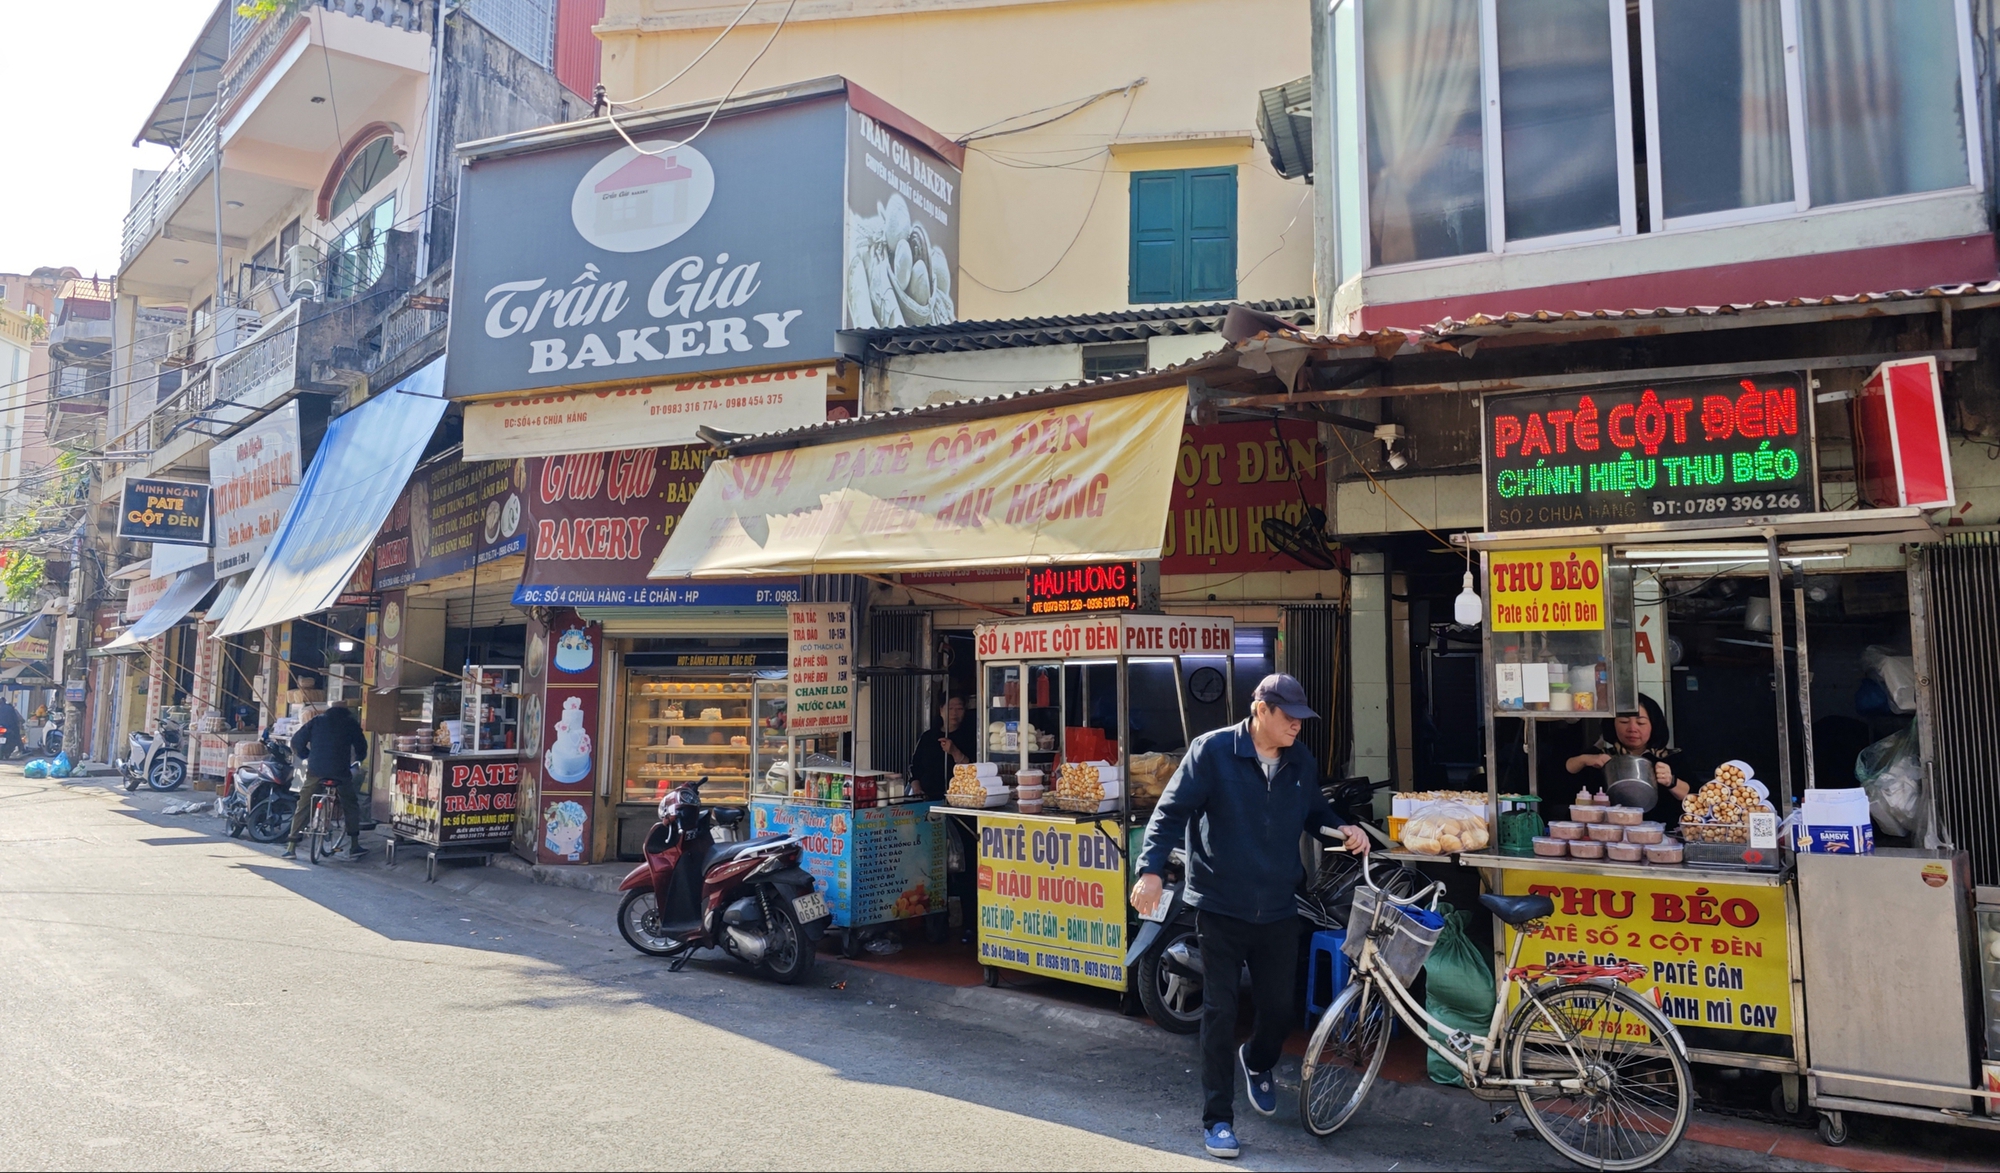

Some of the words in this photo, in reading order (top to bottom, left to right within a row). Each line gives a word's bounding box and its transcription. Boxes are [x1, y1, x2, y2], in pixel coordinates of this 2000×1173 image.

[892, 140, 912, 175] GIA
[913, 156, 953, 206] BAKERY
[913, 190, 922, 208] CÁC
[935, 206, 948, 226] BÁNH
[484, 262, 629, 338] Trần
[647, 252, 762, 321] Gia
[528, 310, 804, 374] BAKERY
[684, 402, 700, 412] 316
[726, 398, 747, 409] 0988
[748, 396, 764, 406] 454
[766, 394, 783, 404] 375
[543, 412, 563, 425] CHÙA
[566, 410, 588, 424] HÀNG
[1495, 396, 1600, 458] PATÊ
[1608, 388, 1693, 456] CỘT
[1701, 379, 1798, 440] ĐÈN
[770, 450, 796, 496] 4
[826, 432, 914, 482] PATÊ
[926, 422, 998, 478] CỘT
[1010, 408, 1095, 454] ĐÈN
[1176, 432, 1226, 498] ỘT
[1237, 428, 1318, 484] ĐÈN
[1497, 458, 1582, 498] CHÍNH
[1588, 451, 1656, 498] HIỆU
[1663, 454, 1724, 487] THU
[1732, 440, 1798, 484] BÉO
[135, 484, 164, 494] MINH
[147, 496, 184, 510] PATE
[1006, 472, 1109, 525] HƯƠNG
[128, 508, 164, 528] CỘT
[168, 512, 199, 528] ĐÈN
[1526, 508, 1534, 523] 2
[1652, 502, 1681, 516] ĐT:
[1684, 498, 1726, 514] 0789
[1732, 496, 1764, 512] 396
[1766, 494, 1800, 510] 266
[534, 517, 649, 560] BAKERY
[1184, 498, 1239, 566] HẬU
[1034, 568, 1064, 599] HẬU
[1067, 566, 1126, 592] HƯƠNG
[1494, 560, 1544, 592] THU
[1550, 552, 1600, 590] BÉO
[525, 590, 543, 602] ĐC:
[544, 586, 559, 602] SỐ
[560, 592, 566, 602] 4
[567, 588, 596, 602] CHÙA
[598, 588, 626, 602] HÀNG
[634, 588, 646, 602] LÊ
[650, 587, 677, 602] CHÂN
[686, 592, 700, 602] HP
[756, 590, 772, 602] ĐT:
[1116, 596, 1130, 606] 179
[828, 612, 846, 622] 10-15K
[1498, 604, 1522, 624] Pate
[1526, 598, 1538, 623] số
[1542, 603, 1549, 622] 2
[1552, 601, 1572, 626] Cột
[1575, 599, 1598, 622] Đèn
[828, 628, 846, 640] 10-15K
[979, 625, 998, 656] SỐ
[1002, 634, 1010, 654] 4
[1014, 630, 1048, 654] PATE
[1052, 624, 1081, 656] CỘT
[1086, 622, 1118, 651] ĐÈN
[1126, 626, 1164, 649] PATE
[1168, 622, 1196, 653] CỘT
[1202, 622, 1230, 650] ĐÈN
[690, 654, 705, 666] BÁNH
[705, 655, 718, 666] KEM
[803, 654, 815, 667] PHÊ
[838, 656, 848, 666] 15K
[804, 670, 815, 683] PHÊ
[838, 671, 848, 681] 15K
[795, 686, 828, 697] CHANH
[831, 685, 848, 694] LEO
[797, 700, 824, 712] NƯỚC
[826, 700, 846, 710] CAM
[452, 764, 518, 787] PATE
[444, 788, 491, 812] TRẦN
[461, 814, 466, 825] 6
[801, 830, 829, 854] NƯỚC
[831, 834, 844, 856] ÉP
[982, 824, 1026, 862] PATÊ
[1032, 826, 1072, 870] CỘT
[1078, 830, 1120, 870] ĐÈN
[799, 894, 820, 910] 15-AS
[997, 870, 1032, 902] HẬU
[1038, 876, 1104, 908] HƯƠNG
[800, 904, 828, 922] 069.22
[1528, 884, 1636, 919] THU
[1651, 886, 1760, 928] BÉO
[982, 904, 998, 928] PATÊ
[1000, 905, 1014, 935] HỘP
[1024, 910, 1040, 934] PATÊ
[1068, 914, 1088, 943] BÁNH
[1106, 924, 1121, 948] CAY
[1528, 924, 1578, 942] PATÊ
[1586, 924, 1619, 946] SỐ
[1627, 932, 1642, 948] 2
[1649, 932, 1702, 956] CỘT
[1711, 936, 1762, 958] ĐÈN
[1045, 954, 1060, 969] 0936
[1060, 956, 1070, 971] 918
[1071, 958, 1080, 974] 179
[1085, 961, 1099, 977] 0979
[1100, 964, 1110, 980] 631
[1111, 966, 1122, 982] 239
[1654, 959, 1698, 986] PATÊ
[1705, 964, 1743, 990] CÂN
[1662, 992, 1700, 1020] ÁNH
[1706, 996, 1732, 1024] MÌ
[1740, 1003, 1778, 1028] CAY
